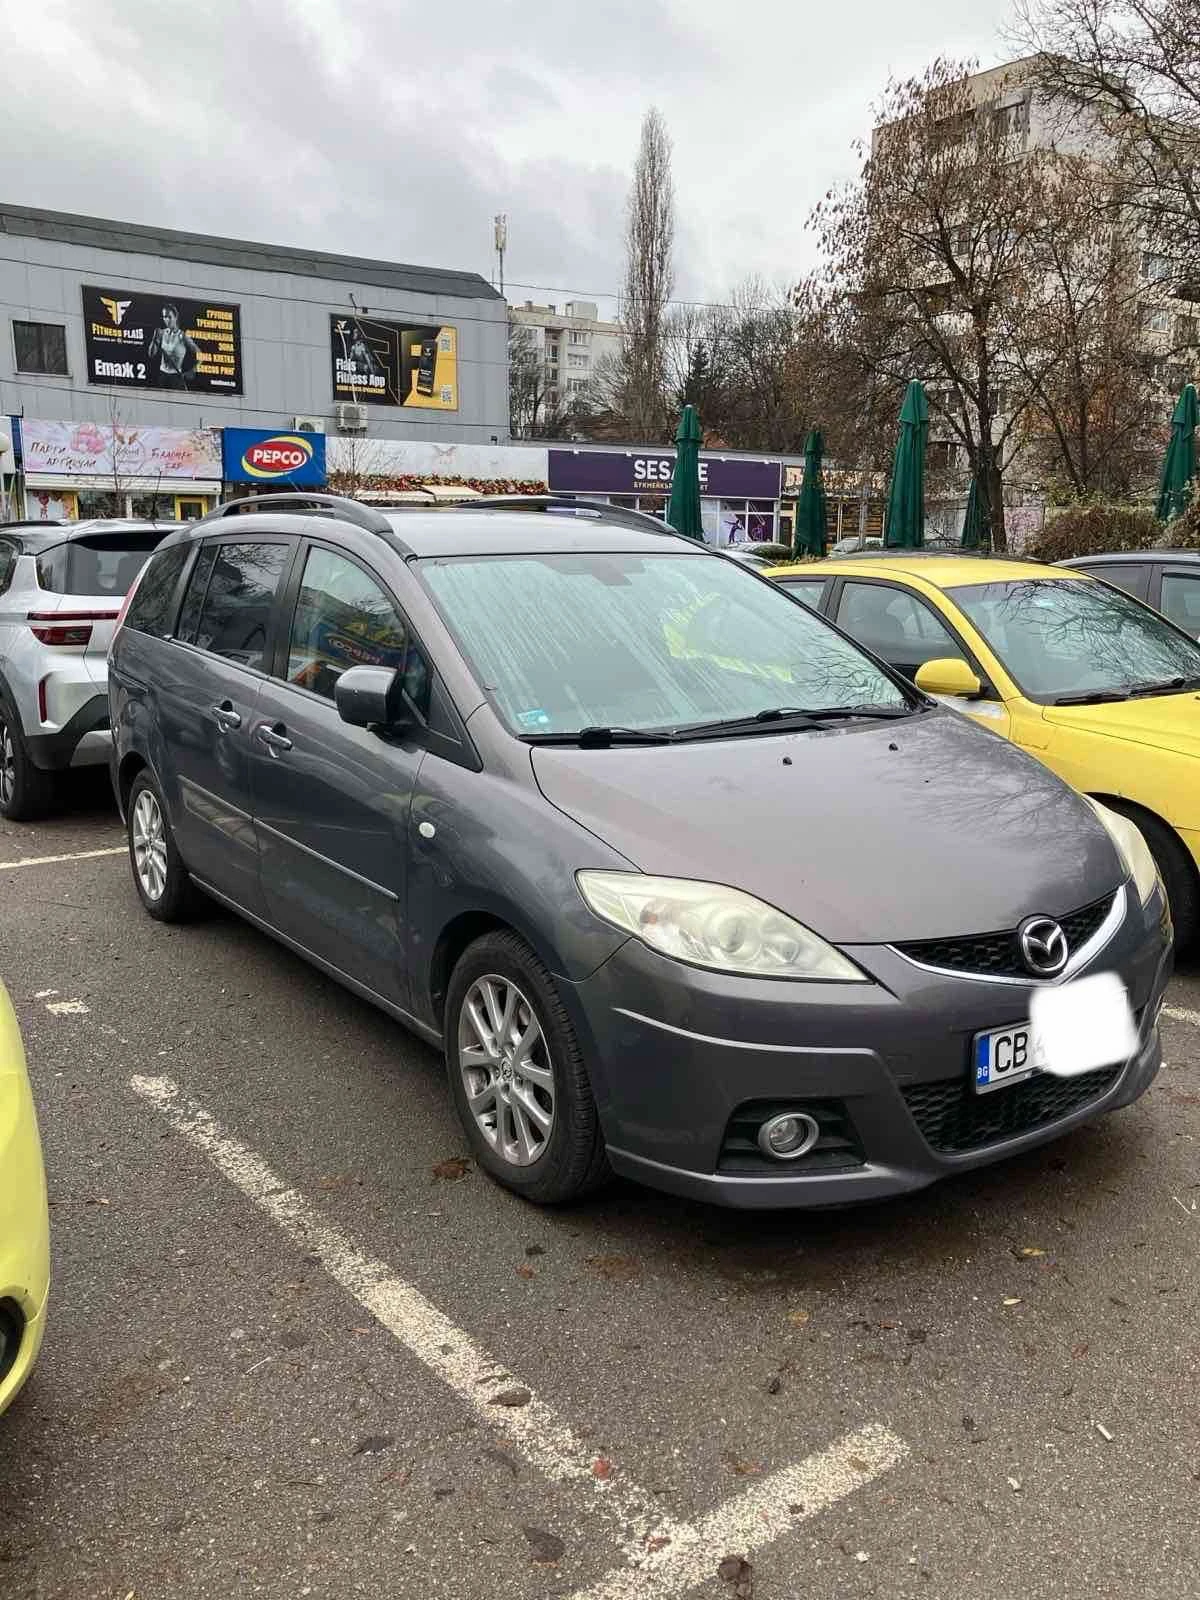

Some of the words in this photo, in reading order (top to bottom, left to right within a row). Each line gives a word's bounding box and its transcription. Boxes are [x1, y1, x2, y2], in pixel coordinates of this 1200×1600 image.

[137, 363, 146, 379] 2
[336, 371, 368, 385] Fitness
[369, 374, 386, 388] App
[253, 449, 302, 465] PEPCO
[634, 459, 709, 481] SESE
[633, 481, 673, 490] БУКМЕЙКЪР
[995, 1032, 1028, 1073] CB
[977, 1066, 989, 1079] BG
